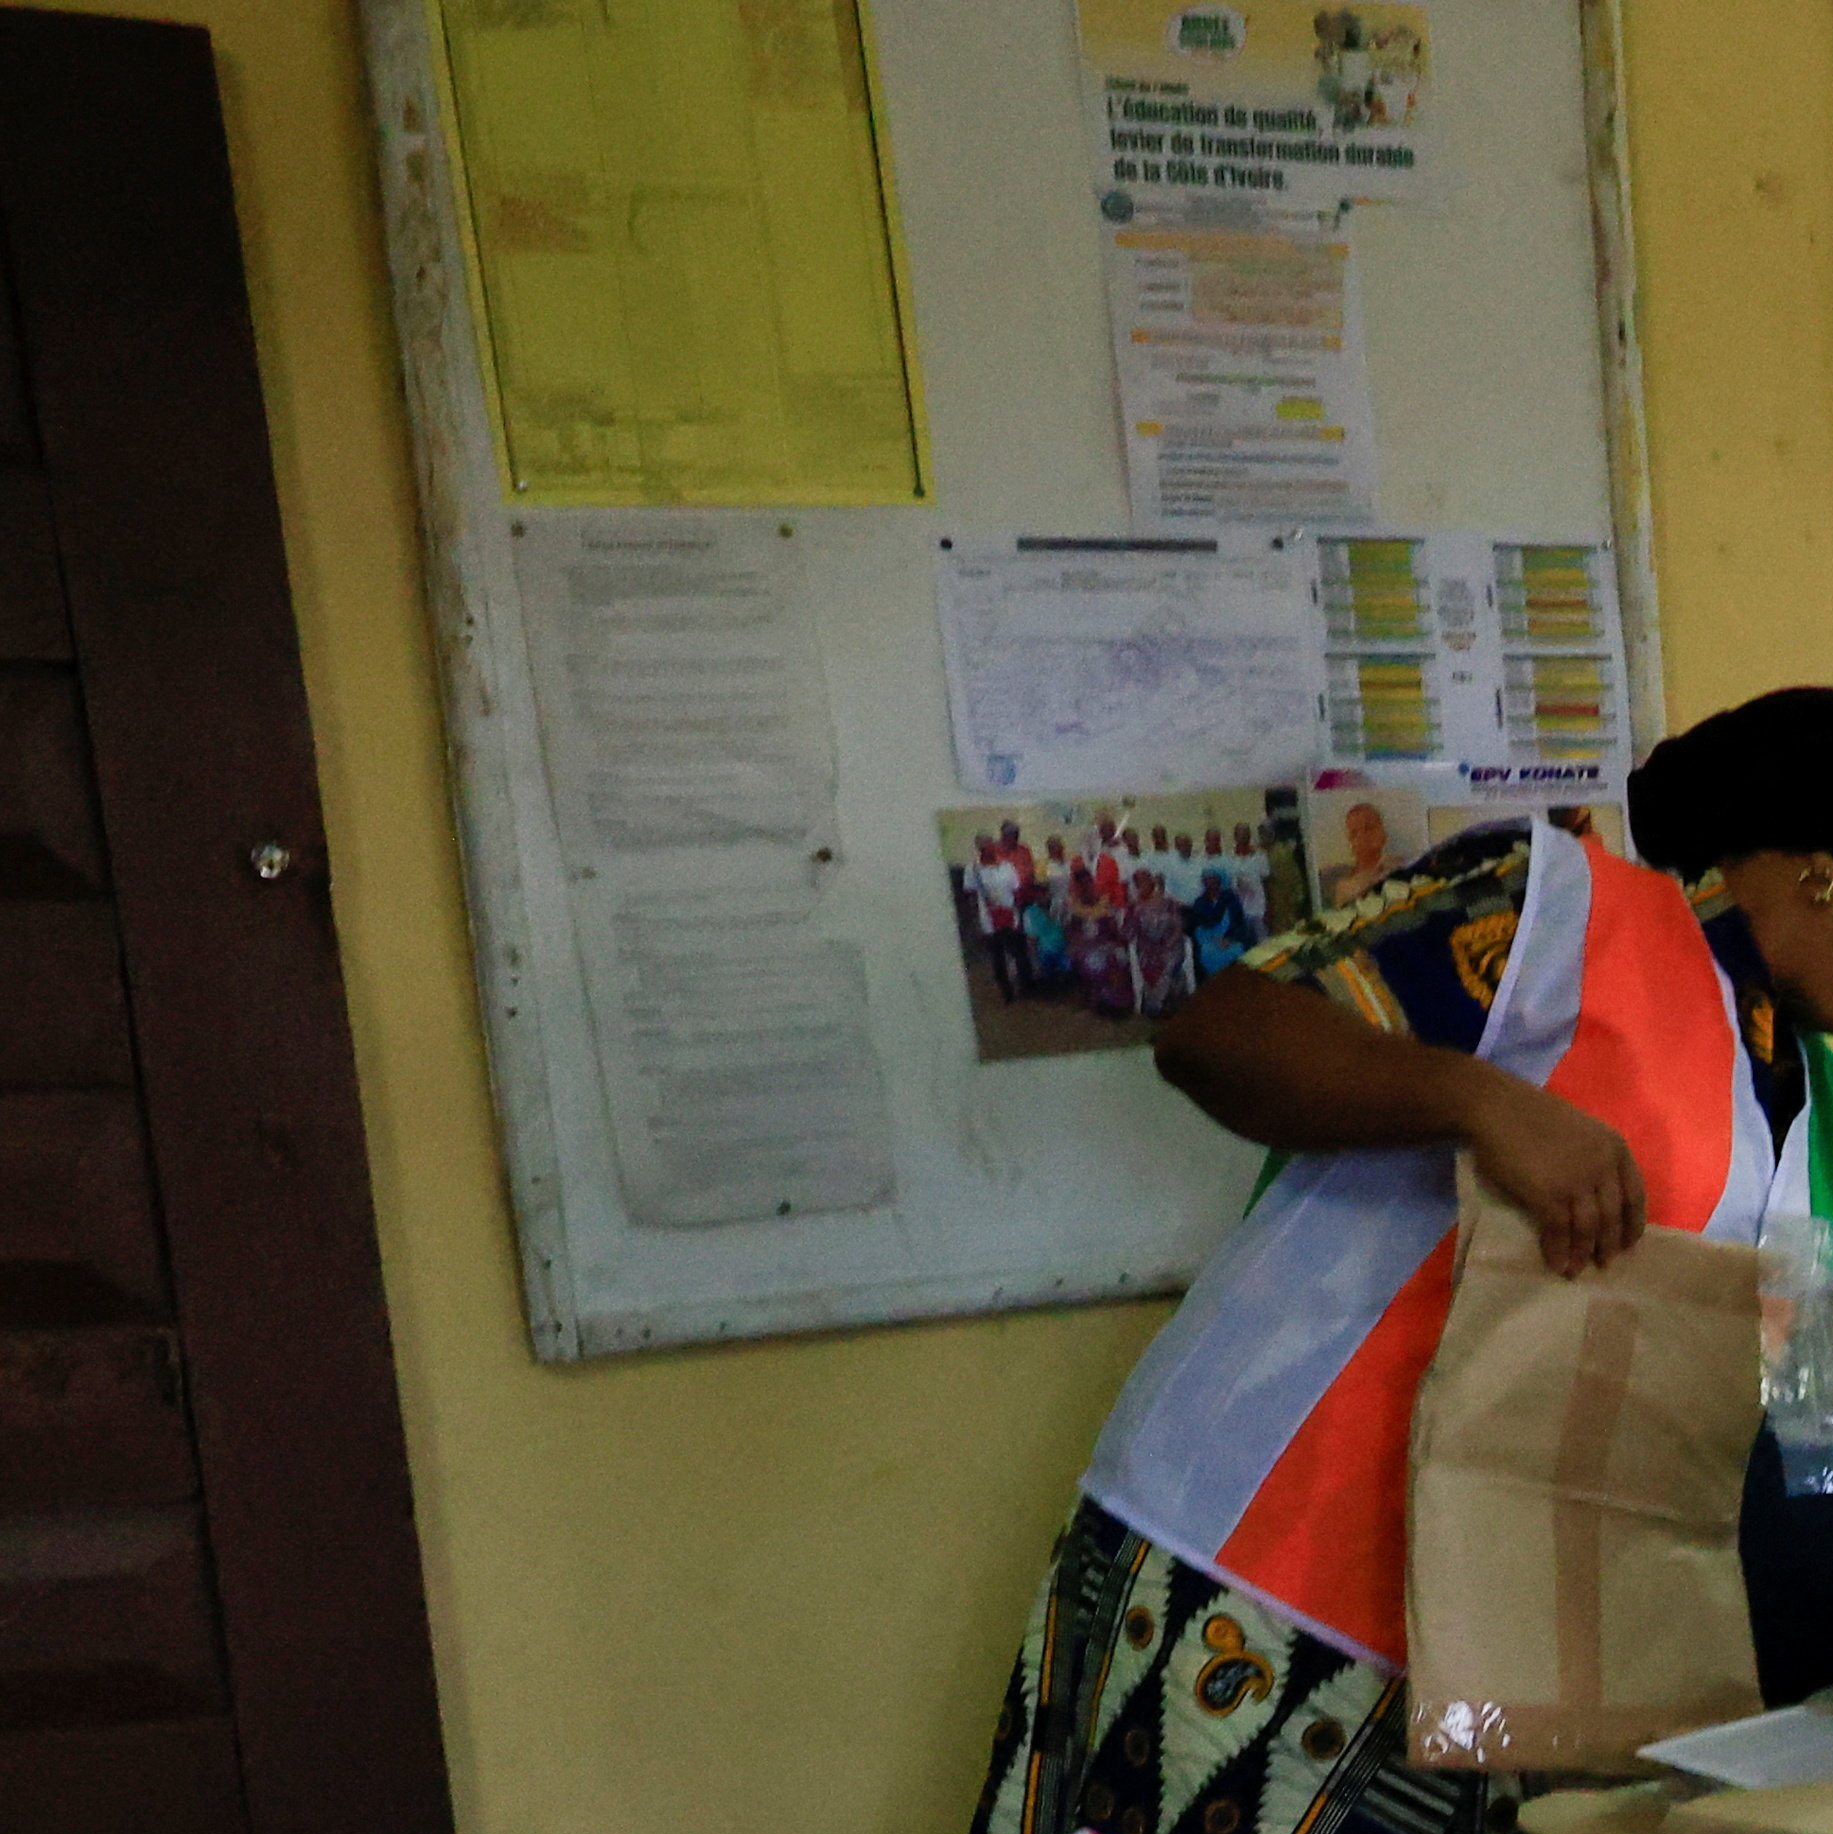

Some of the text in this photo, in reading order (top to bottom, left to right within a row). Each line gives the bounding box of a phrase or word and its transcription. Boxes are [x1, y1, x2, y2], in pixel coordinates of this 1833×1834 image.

[1224, 104, 1247, 128] de
[1110, 127, 1414, 168] levier de transformation durable
[1114, 156, 1138, 181] de
[1143, 159, 1161, 183] la
[1166, 158, 1209, 186] Côte
